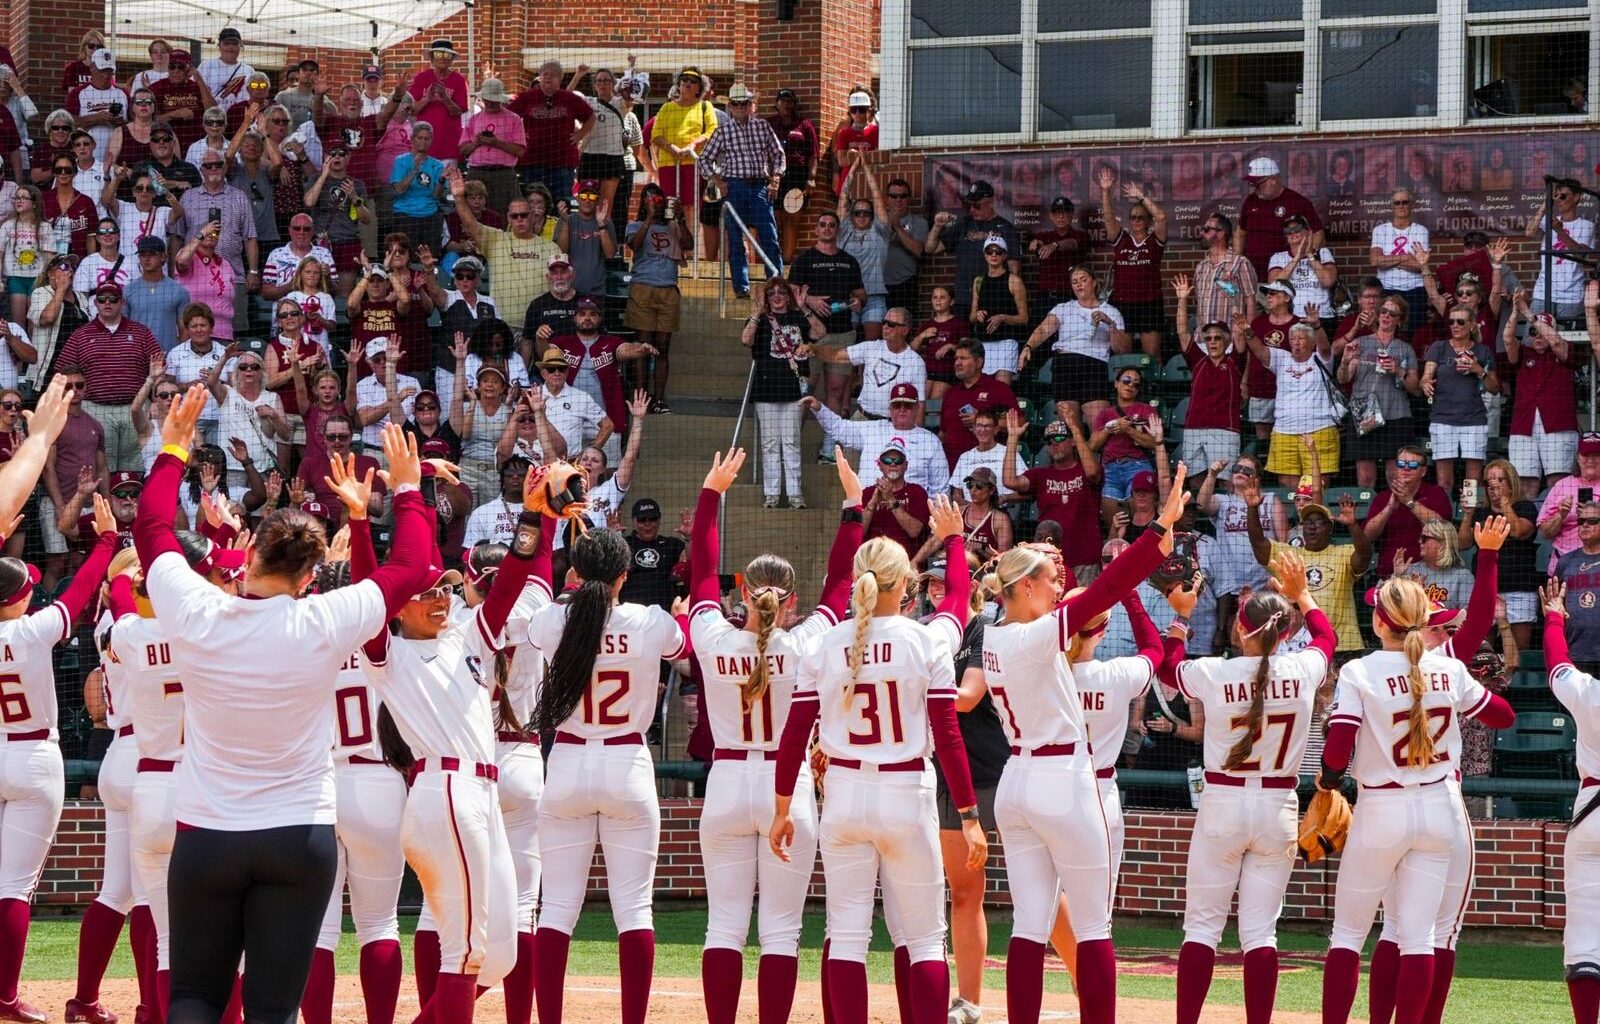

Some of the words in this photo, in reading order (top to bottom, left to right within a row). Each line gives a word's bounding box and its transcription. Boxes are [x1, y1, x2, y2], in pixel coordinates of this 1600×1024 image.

[1436, 215, 1495, 231] FLORIDA
[146, 643, 171, 666] BU
[597, 633, 628, 654] SS
[716, 654, 785, 676] DANEY
[983, 650, 1001, 673] PSEL
[1223, 679, 1301, 703] HARLEY
[1386, 672, 1451, 697] POER
[582, 670, 630, 725] 12
[1078, 691, 1105, 711] NG
[740, 683, 773, 742] 11
[844, 680, 904, 745] 31
